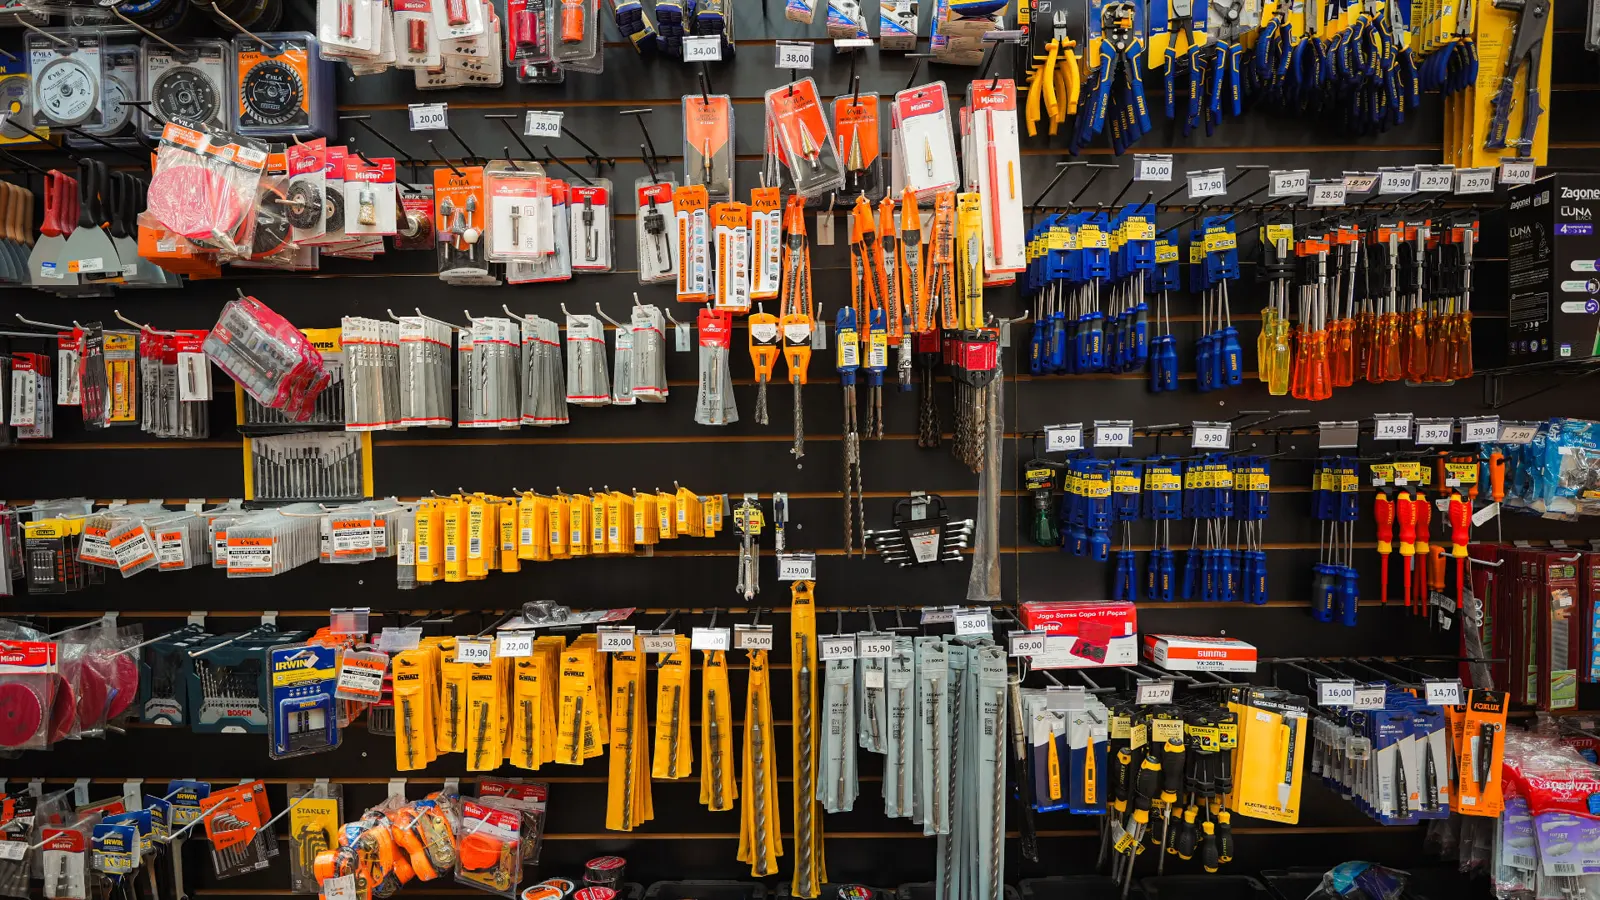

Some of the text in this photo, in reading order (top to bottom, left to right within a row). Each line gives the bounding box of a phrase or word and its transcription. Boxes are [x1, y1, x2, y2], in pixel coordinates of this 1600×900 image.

[404, 2, 425, 10] Mister
[693, 47, 717, 56] 34,00
[785, 53, 810, 63] 38,00
[980, 96, 1006, 104] Mister
[910, 101, 931, 112] Mister
[1136, 95, 1145, 116] IRWIN
[419, 113, 443, 124] 20,00
[535, 122, 558, 132] 28,00
[355, 171, 382, 180] Mister
[1145, 166, 1169, 176] 10,00
[1506, 169, 1530, 179] 34,00
[1198, 181, 1222, 191] 17,90
[1281, 178, 1305, 189] 29,70
[1387, 178, 1411, 187] 19,90
[1426, 177, 1449, 186] 29,70
[1467, 178, 1490, 188] 29,70
[1320, 190, 1343, 199] 28,50
[685, 199, 702, 207] VILA
[1560, 205, 1592, 217] LUNA
[1082, 223, 1100, 231] IRWIN
[1205, 226, 1226, 234] IRWIN
[1560, 223, 1568, 234] 4
[1383, 425, 1407, 434] 14,98
[1424, 429, 1449, 439] 39,70
[1472, 426, 1496, 437] 39,90
[1057, 434, 1076, 444] 8,90
[1104, 433, 1123, 442] 9,00
[1204, 433, 1223, 442] 9,90
[1510, 431, 1530, 439] 7,90
[786, 566, 809, 576] 219,00
[1037, 612, 1055, 620] Jogo
[1106, 610, 1127, 618] Peças
[962, 619, 986, 629] 58,00
[1034, 623, 1060, 632] Mister
[506, 641, 530, 651] 22,00
[607, 637, 632, 647] 28,00
[650, 639, 673, 649] 38,90
[747, 637, 771, 646] 94,00
[1018, 641, 1043, 651] 69,00
[464, 648, 489, 658] 19,90
[829, 645, 853, 655] 19,90
[866, 644, 891, 654] 15,90
[0, 655, 24, 663] Mister
[396, 673, 420, 681] DEWALT
[471, 674, 493, 682] DEWALT
[1147, 689, 1171, 699] 11,70
[1328, 688, 1352, 698] 16,00
[1433, 688, 1457, 698] 14,70
[1359, 695, 1384, 705] 19,90
[1473, 702, 1500, 712] FOXLUX
[227, 709, 252, 717] BOSCH
[481, 785, 502, 793] Mister
[176, 793, 198, 801] IRWIN
[296, 807, 331, 816] STANLEY
[464, 805, 482, 815] Mister
